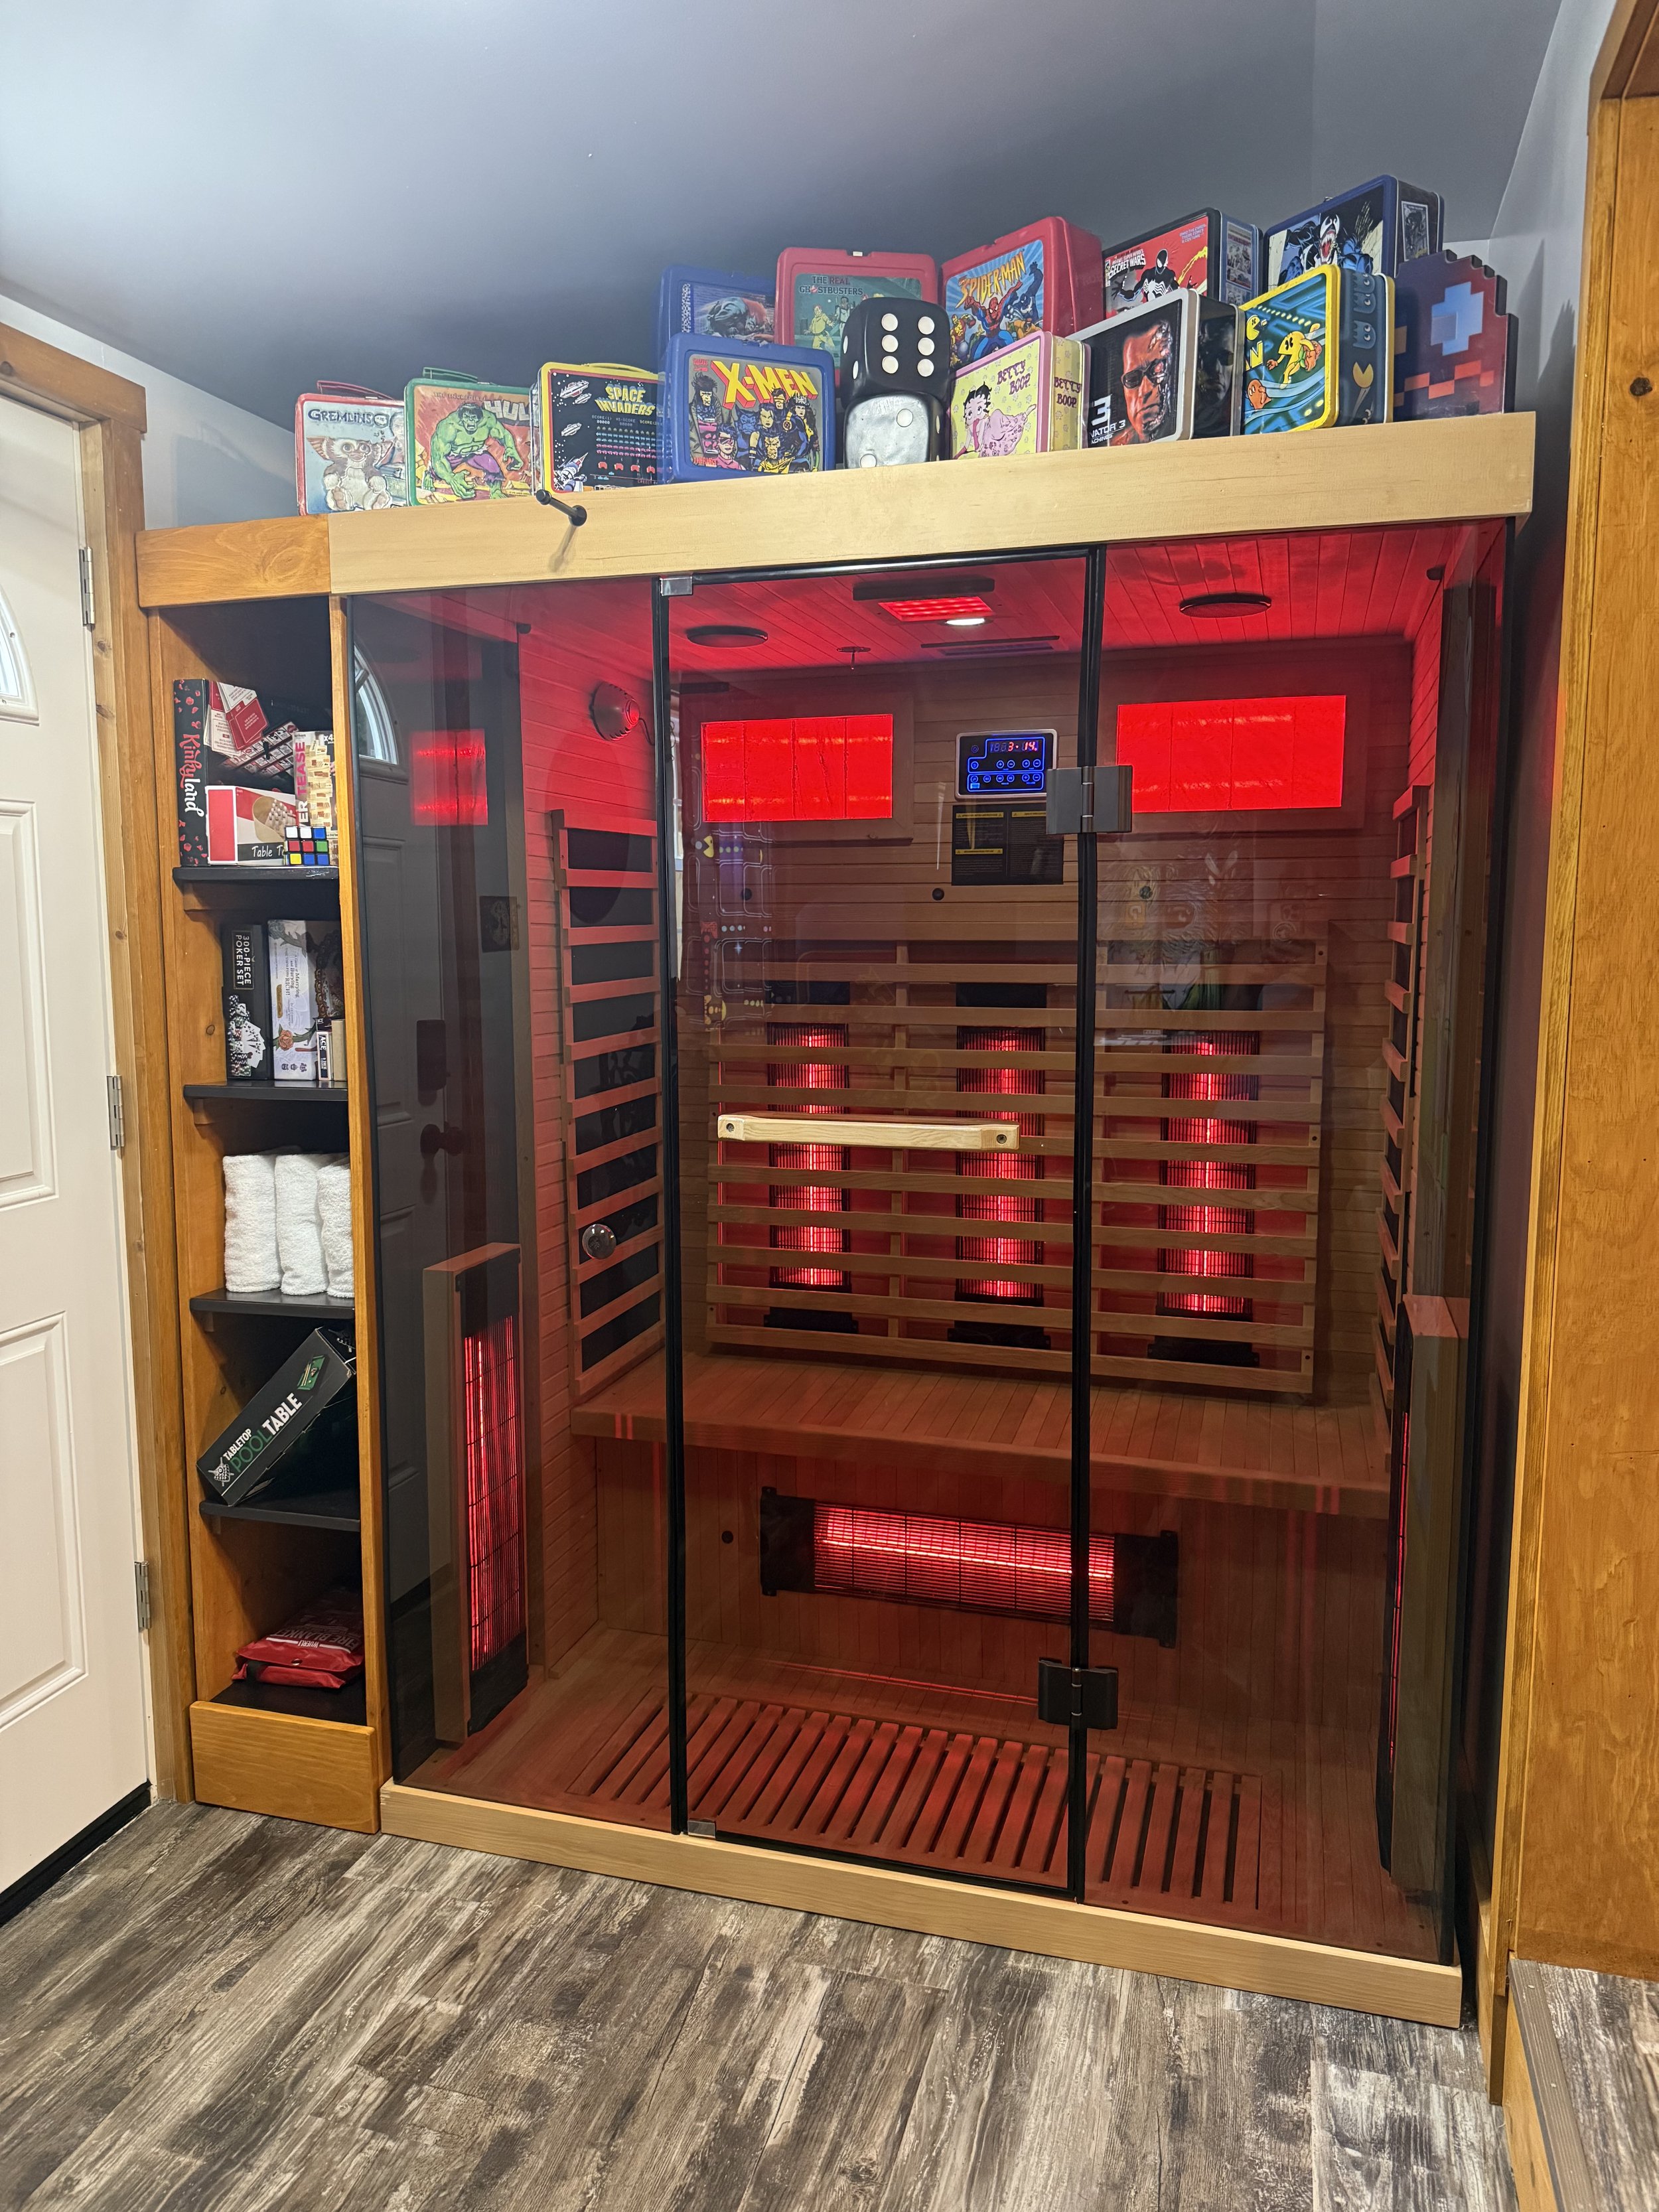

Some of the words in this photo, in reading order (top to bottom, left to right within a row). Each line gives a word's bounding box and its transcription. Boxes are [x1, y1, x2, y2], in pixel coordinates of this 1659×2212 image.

[1109, 259, 1129, 279] SECRET
[1129, 253, 1147, 267] WARS
[955, 251, 1027, 309] SPIDER-MAN
[711, 360, 818, 409] X-MEN
[997, 359, 1026, 385] BETTY
[605, 384, 646, 403] SPACE
[1054, 377, 1082, 394] BETTY
[483, 400, 531, 423] HUL
[595, 397, 656, 416] INVADERS
[1056, 394, 1077, 408] BOOP
[1091, 394, 1113, 426] 3
[308, 409, 374, 426] GREMLINS
[1119, 419, 1125, 429] 3
[295, 741, 307, 797] TEASE
[252, 845, 273, 857] Table
[243, 935, 252, 985] 300-PIECE
[223, 1428, 252, 1461] TABLETOP
[230, 1430, 274, 1473] POOL
[261, 1392, 303, 1436] TABLE
